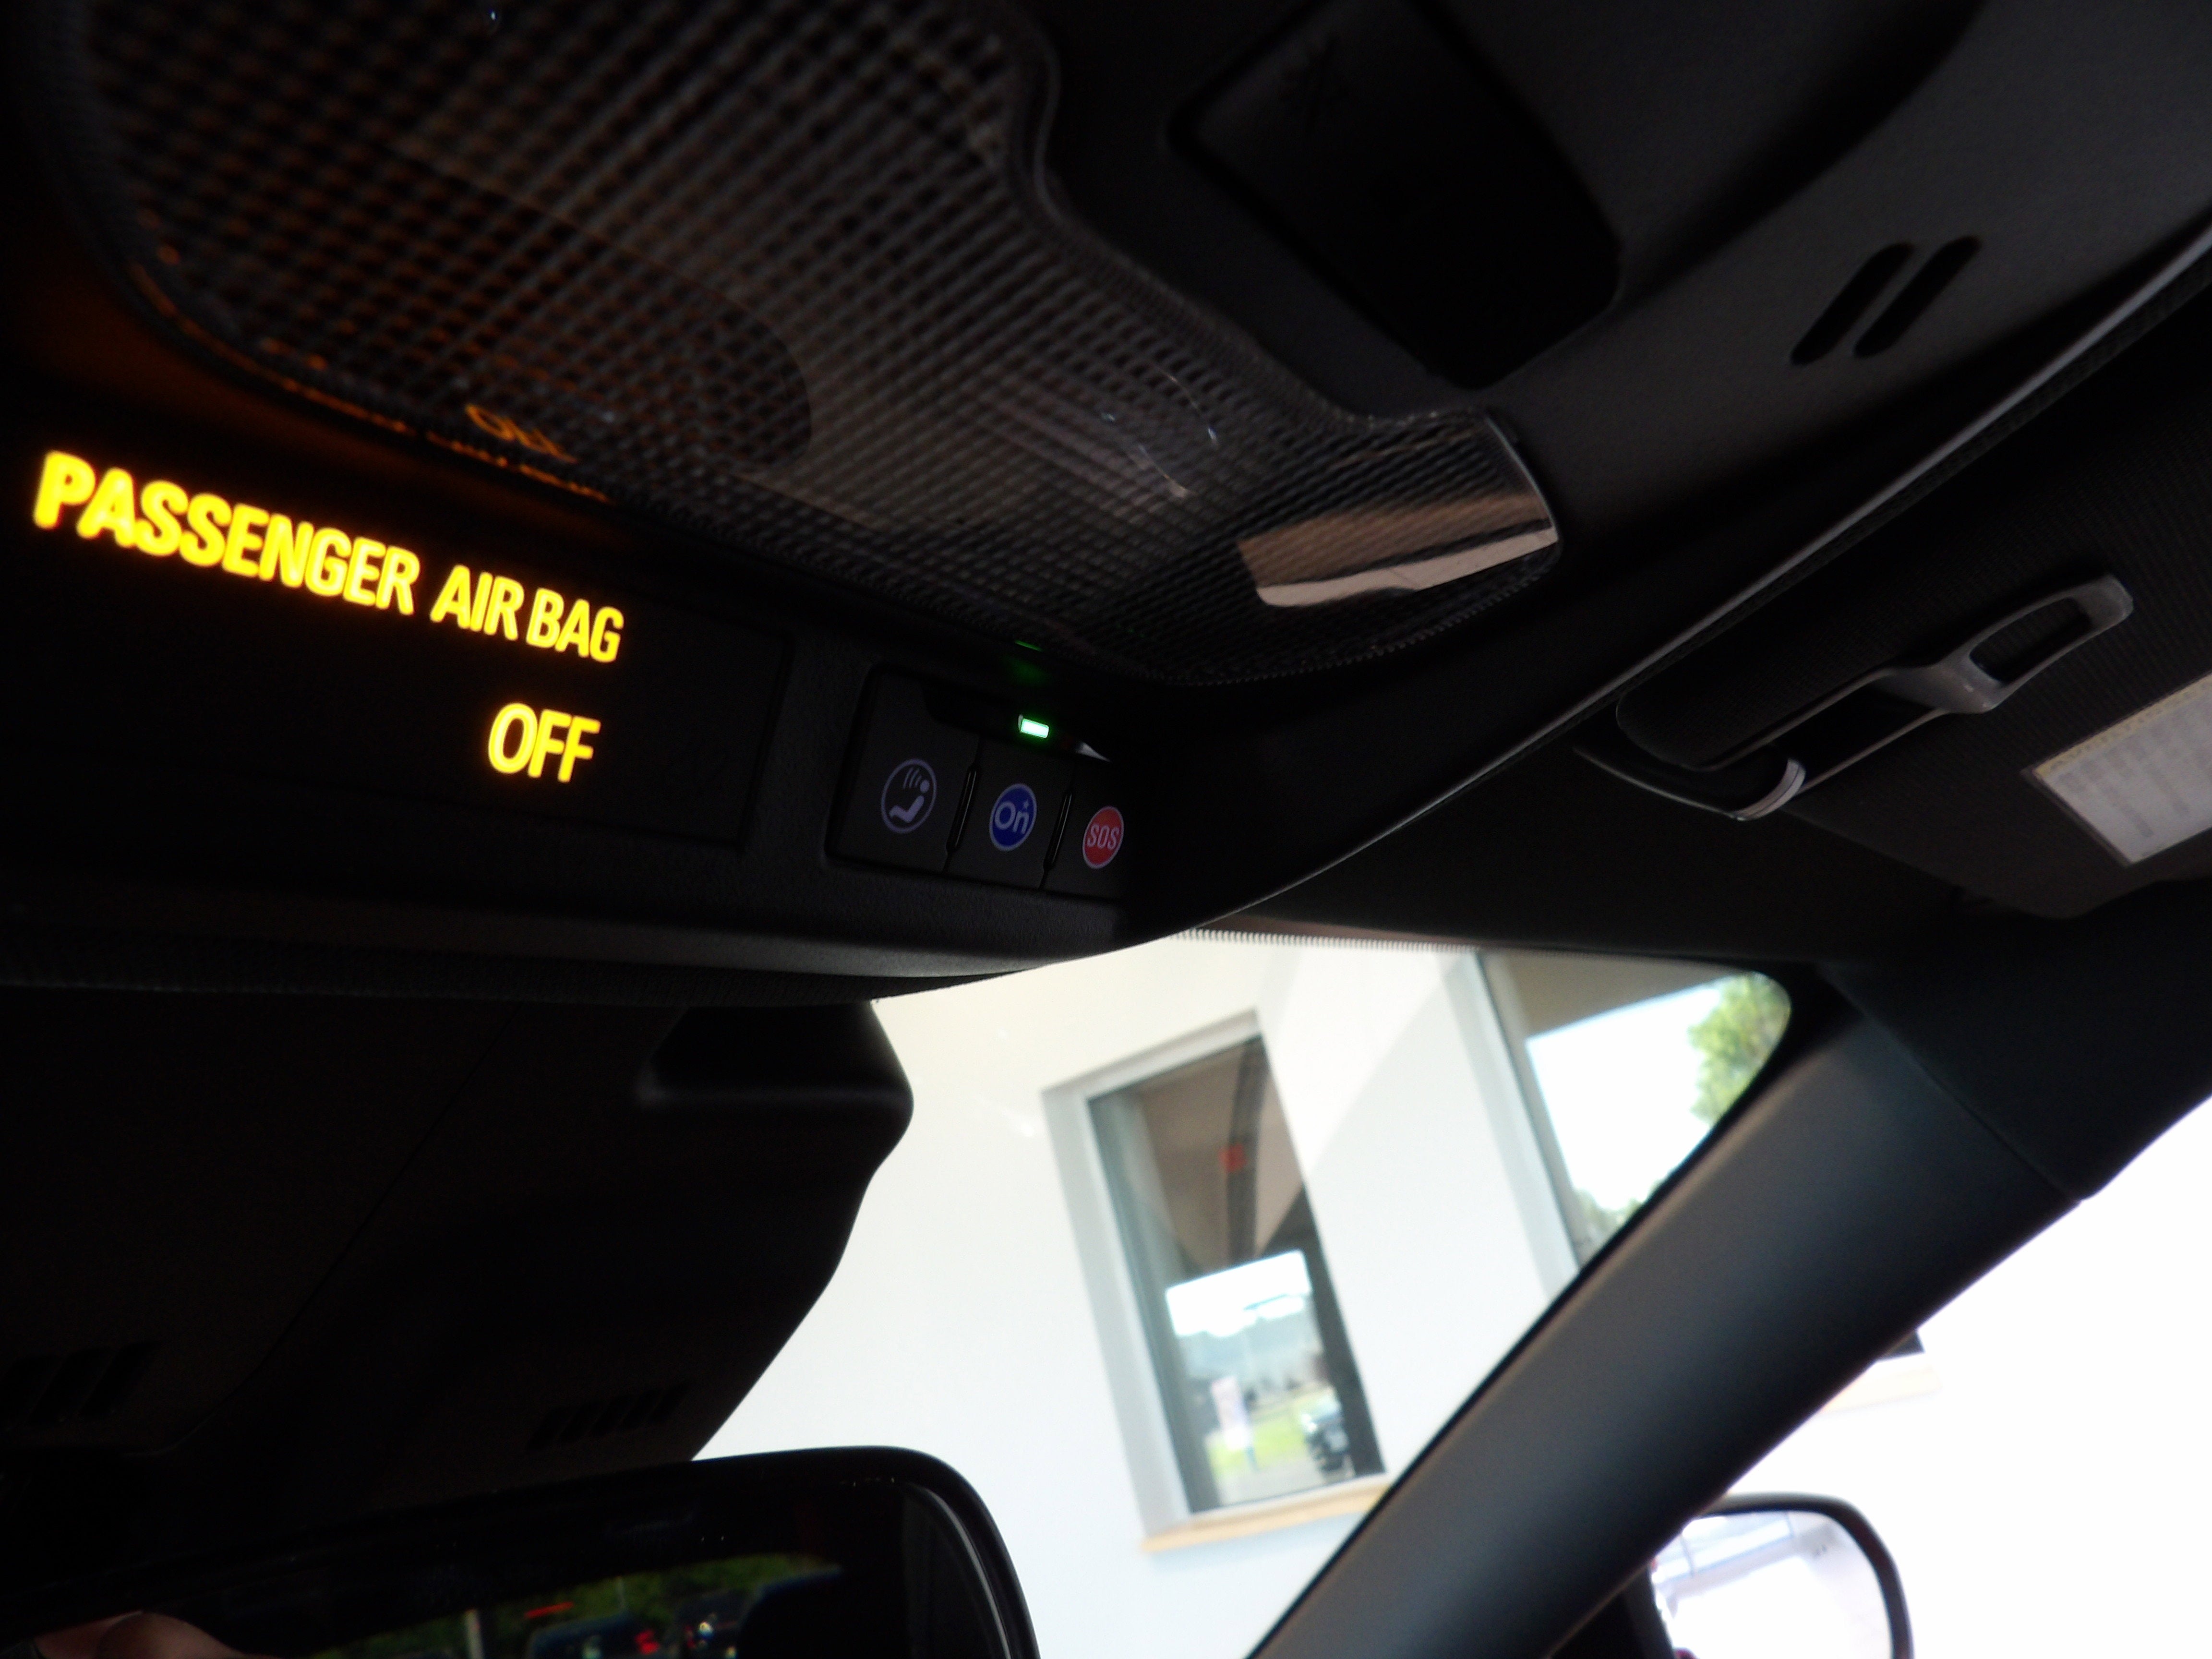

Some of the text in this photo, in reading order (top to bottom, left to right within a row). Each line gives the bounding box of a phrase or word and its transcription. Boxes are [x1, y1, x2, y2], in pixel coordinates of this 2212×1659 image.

[34, 451, 421, 615] PASSENGER
[488, 703, 601, 782] OFF
[995, 801, 1030, 835] On
[1087, 824, 1119, 850] SOS
